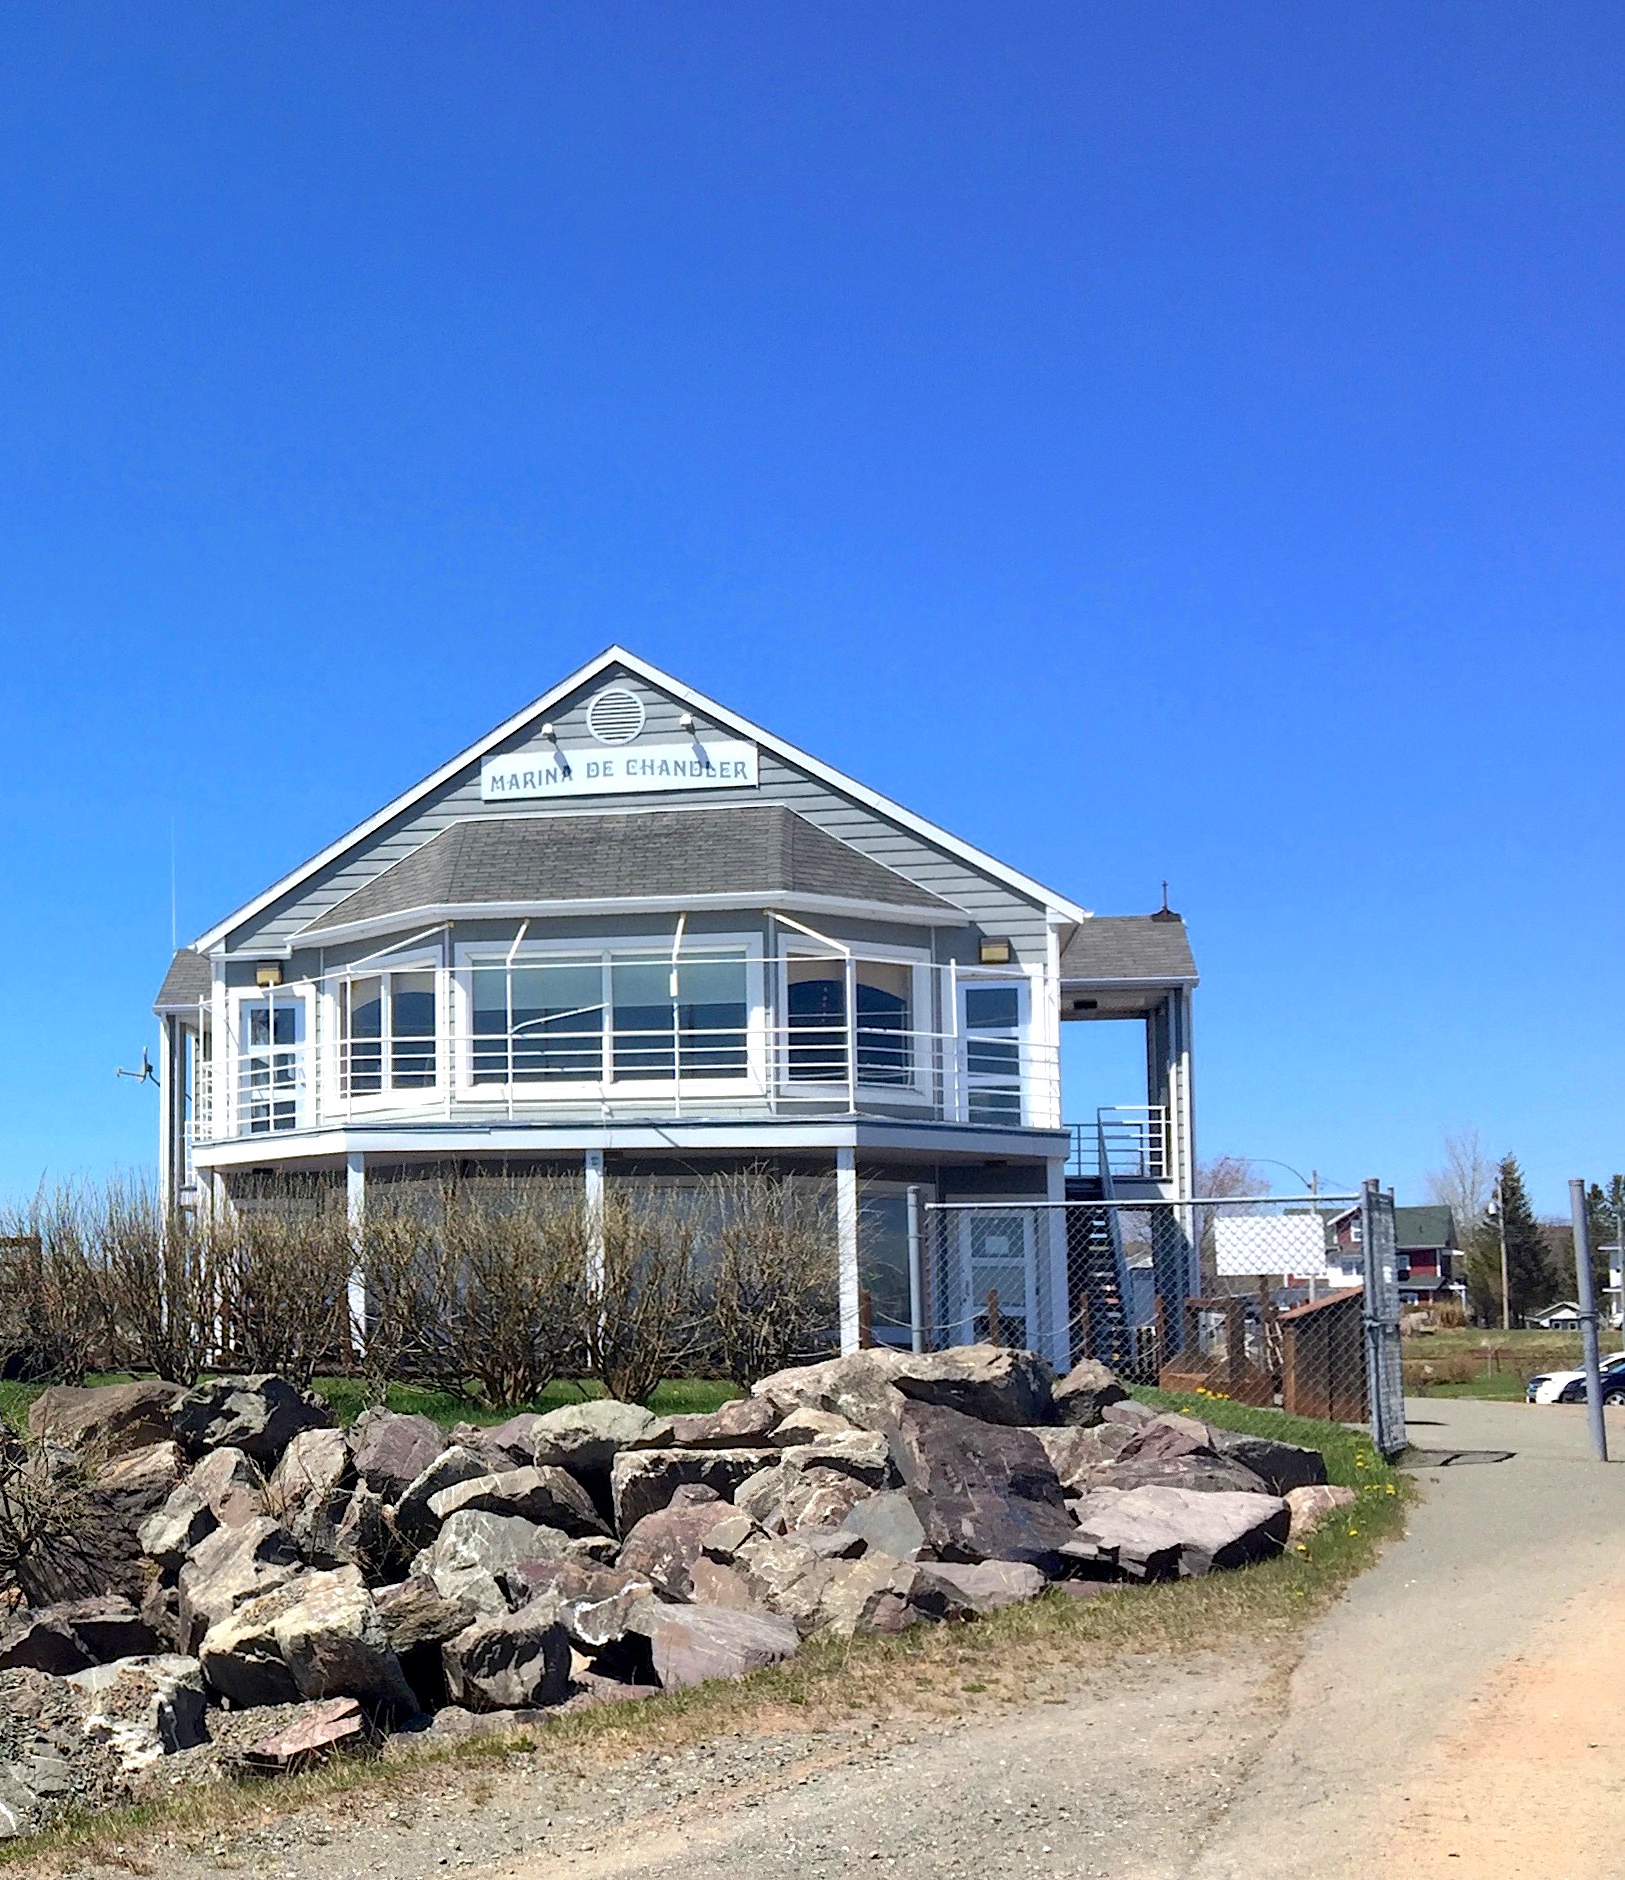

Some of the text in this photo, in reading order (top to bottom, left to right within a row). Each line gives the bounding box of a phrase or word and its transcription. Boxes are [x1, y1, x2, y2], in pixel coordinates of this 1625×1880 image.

[490, 758, 748, 792] MARINA DE CHANDLER
